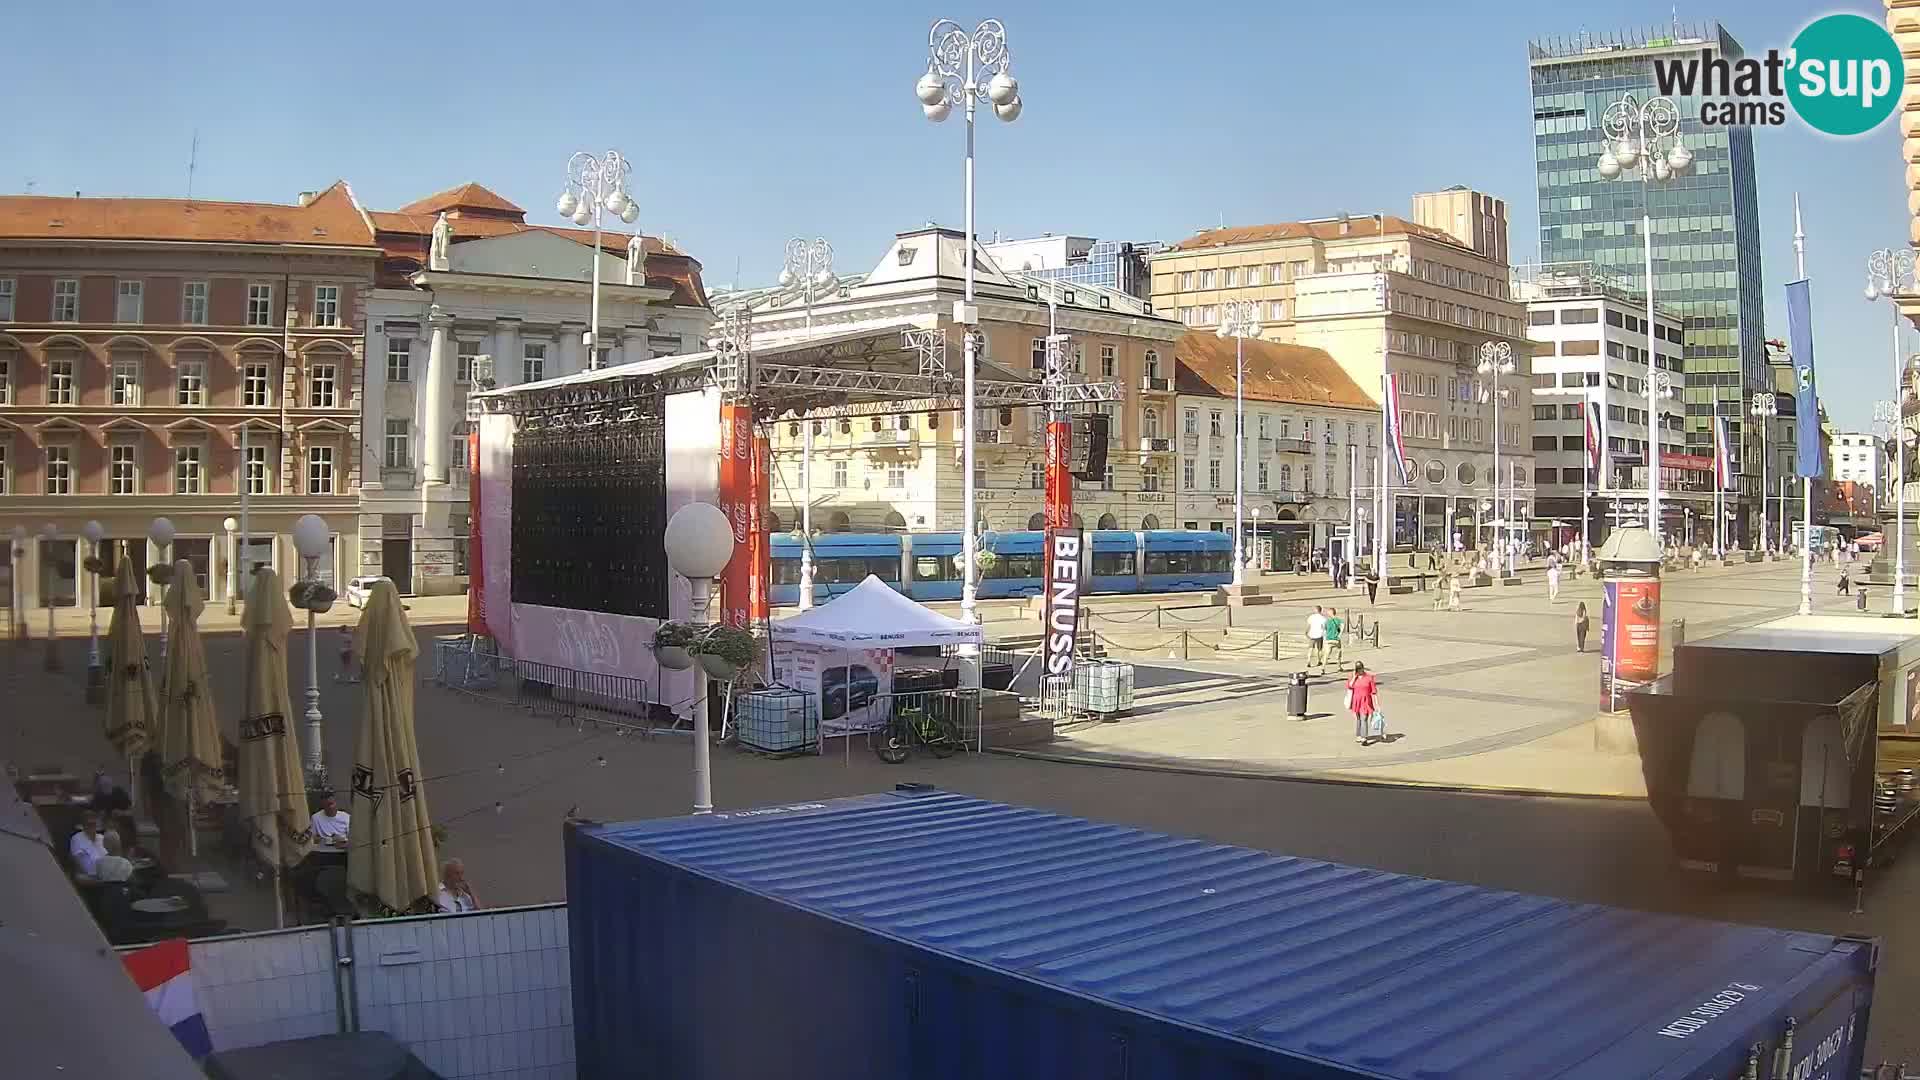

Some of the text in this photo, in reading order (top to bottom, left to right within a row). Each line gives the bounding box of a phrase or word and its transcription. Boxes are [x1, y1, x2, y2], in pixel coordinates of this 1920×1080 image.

[735, 416, 748, 459] Coca-Cola
[734, 503, 746, 544] Coca-Cola
[1691, 990, 1745, 1018] 300629
